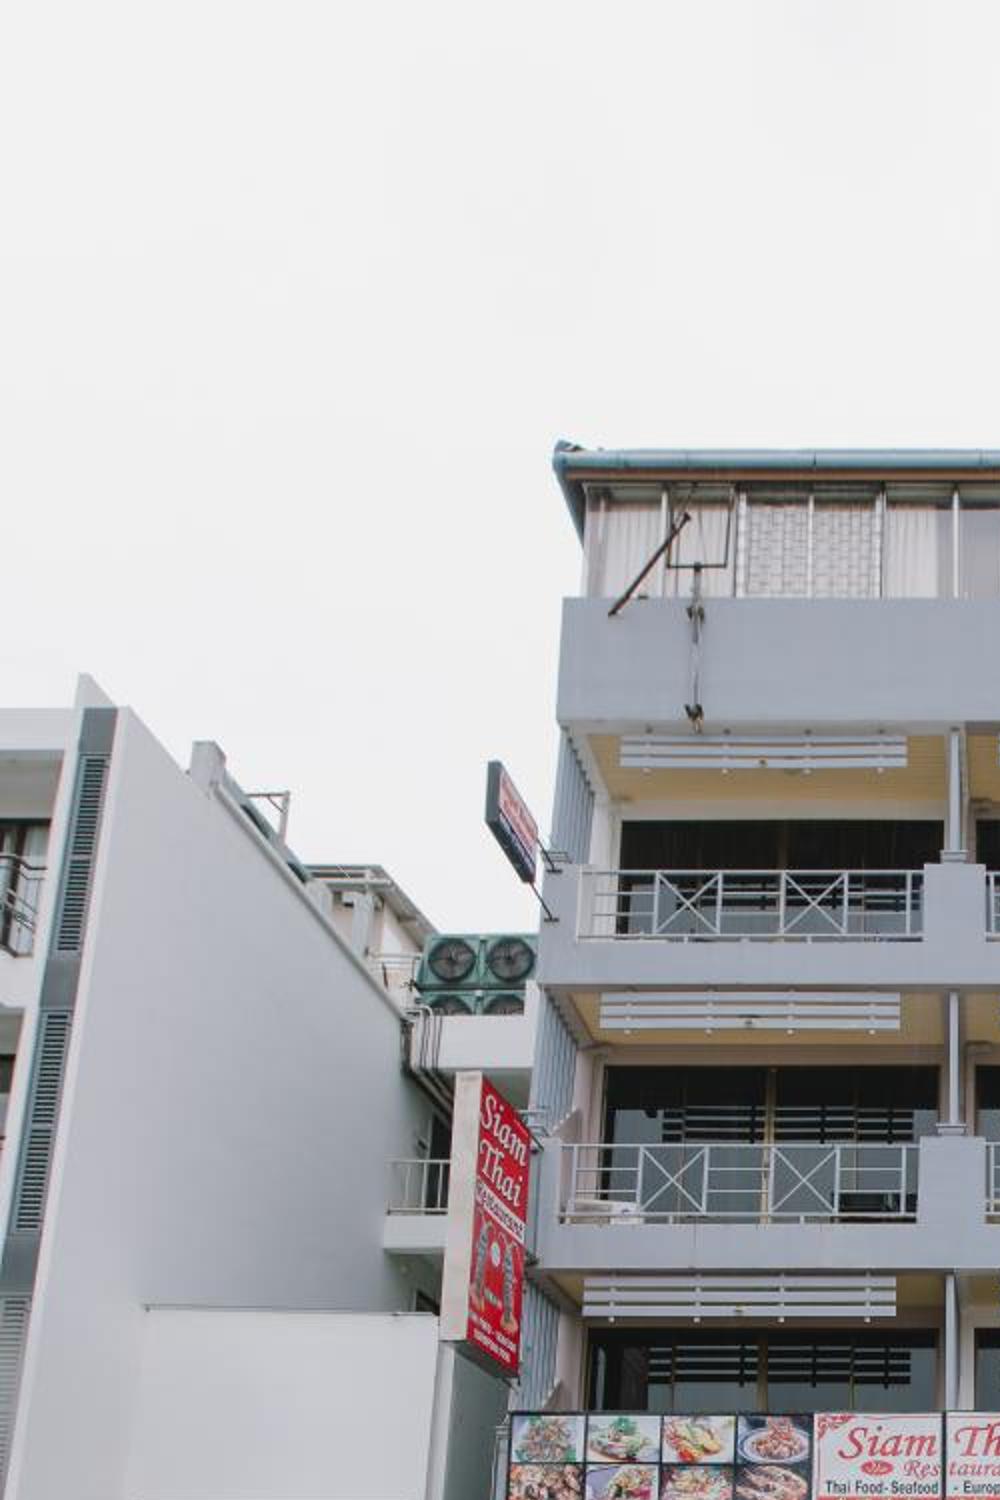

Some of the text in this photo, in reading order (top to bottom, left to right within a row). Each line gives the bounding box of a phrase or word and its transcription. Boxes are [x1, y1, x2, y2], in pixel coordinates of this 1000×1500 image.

[481, 1094, 526, 1167] Siam
[480, 1139, 523, 1207] Thai
[838, 1425, 937, 1459] Siam
[826, 1480, 851, 1494] Thai
